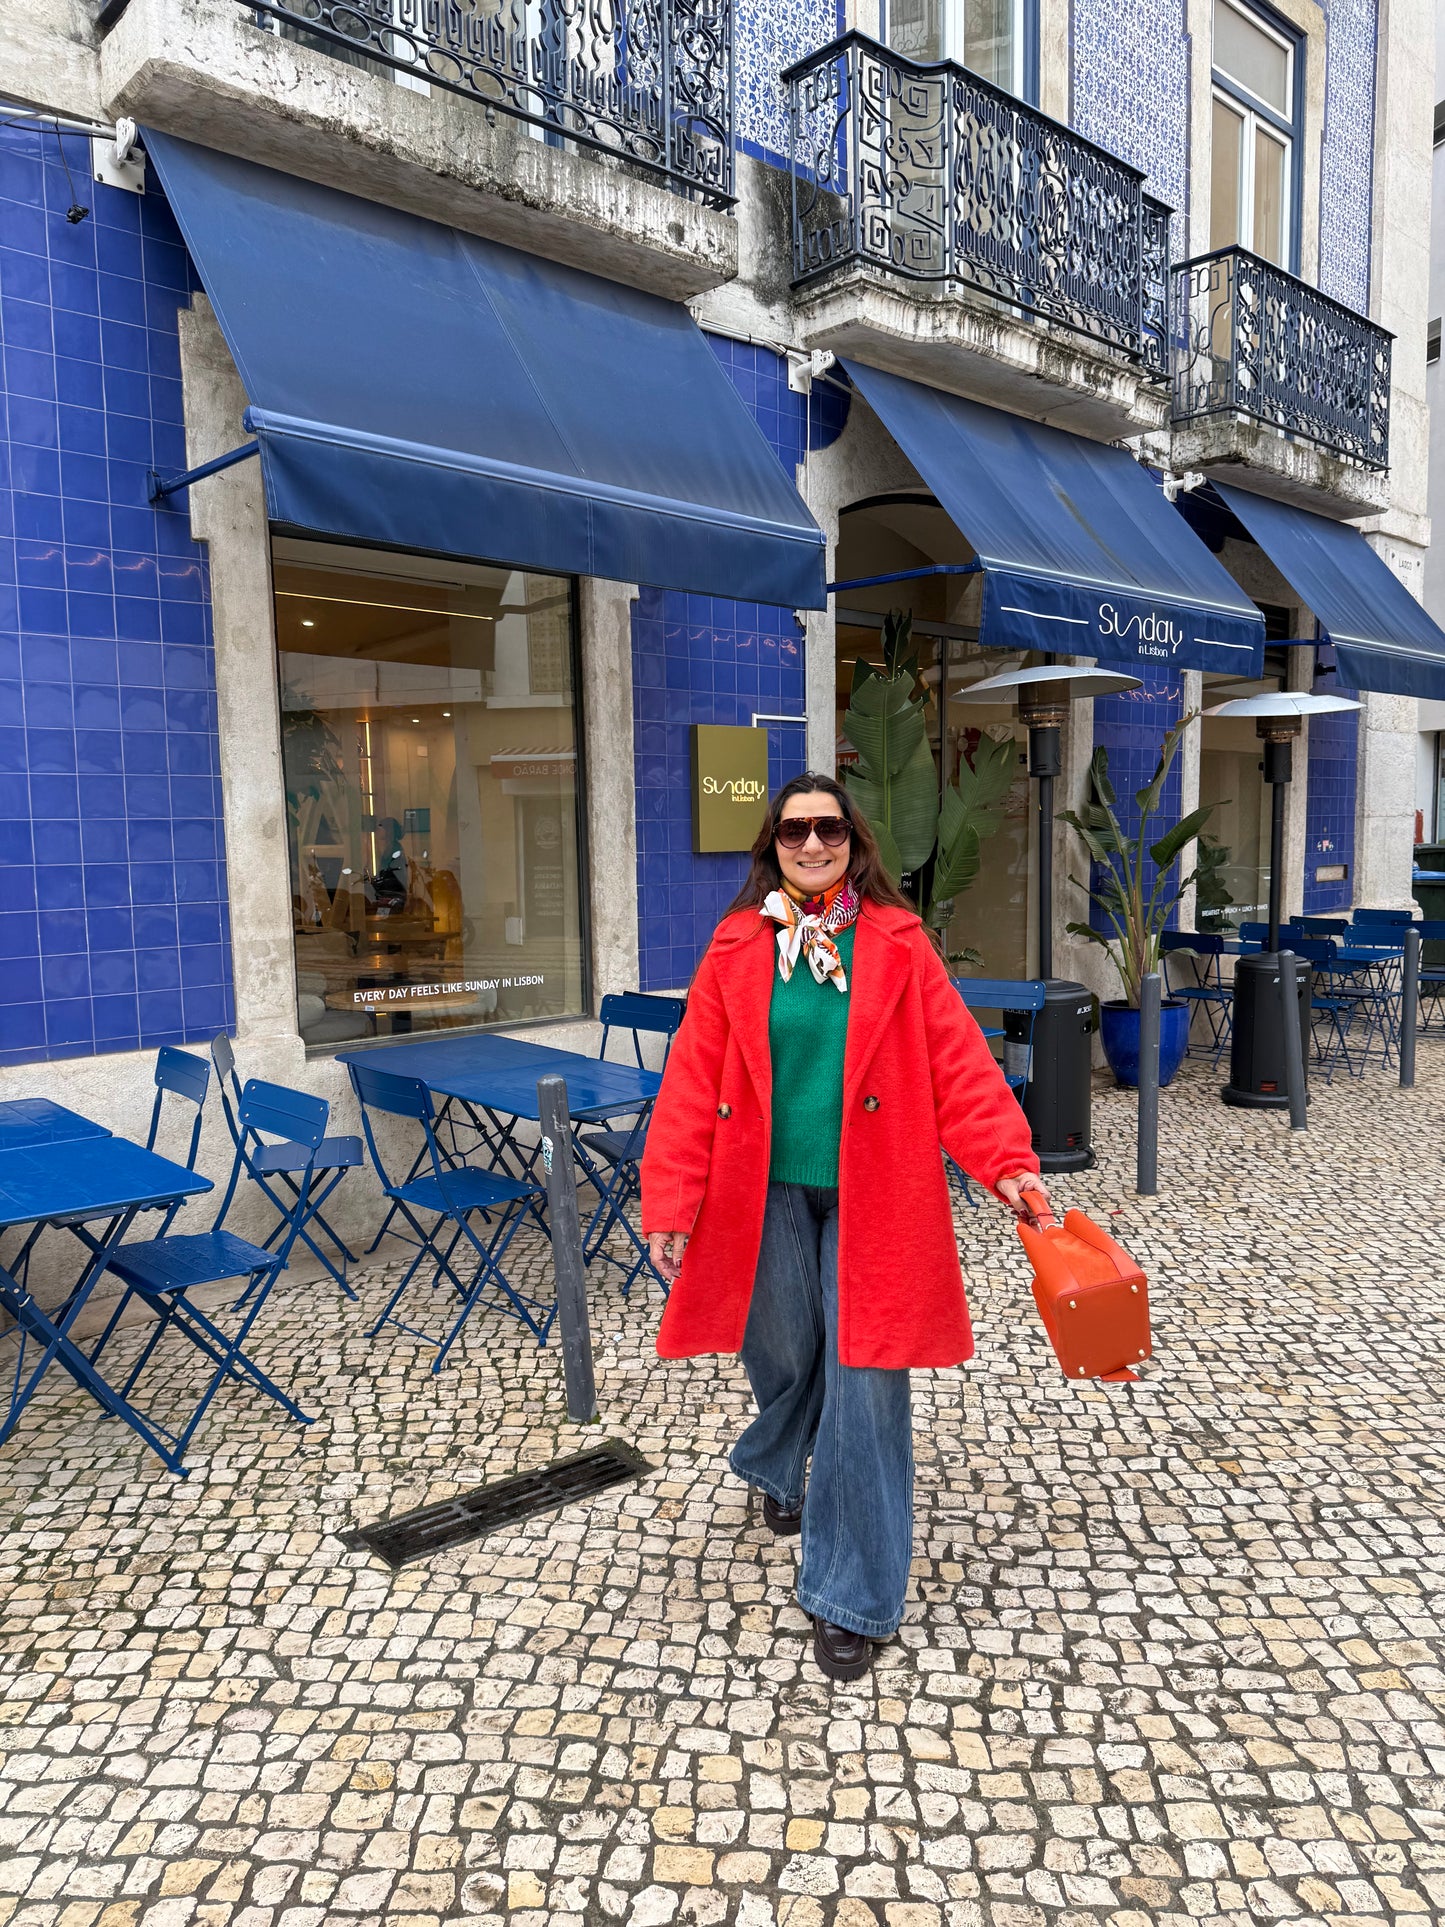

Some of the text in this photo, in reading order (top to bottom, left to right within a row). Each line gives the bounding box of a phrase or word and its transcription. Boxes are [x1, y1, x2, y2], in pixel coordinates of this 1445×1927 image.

[1098, 603, 1183, 654] Sunday
[1145, 643, 1168, 658] Lisbon
[703, 776, 765, 800] Sunday
[353, 974, 544, 1003] EVERY DAY FEELS LIKE SUNDAY IN LISBON
